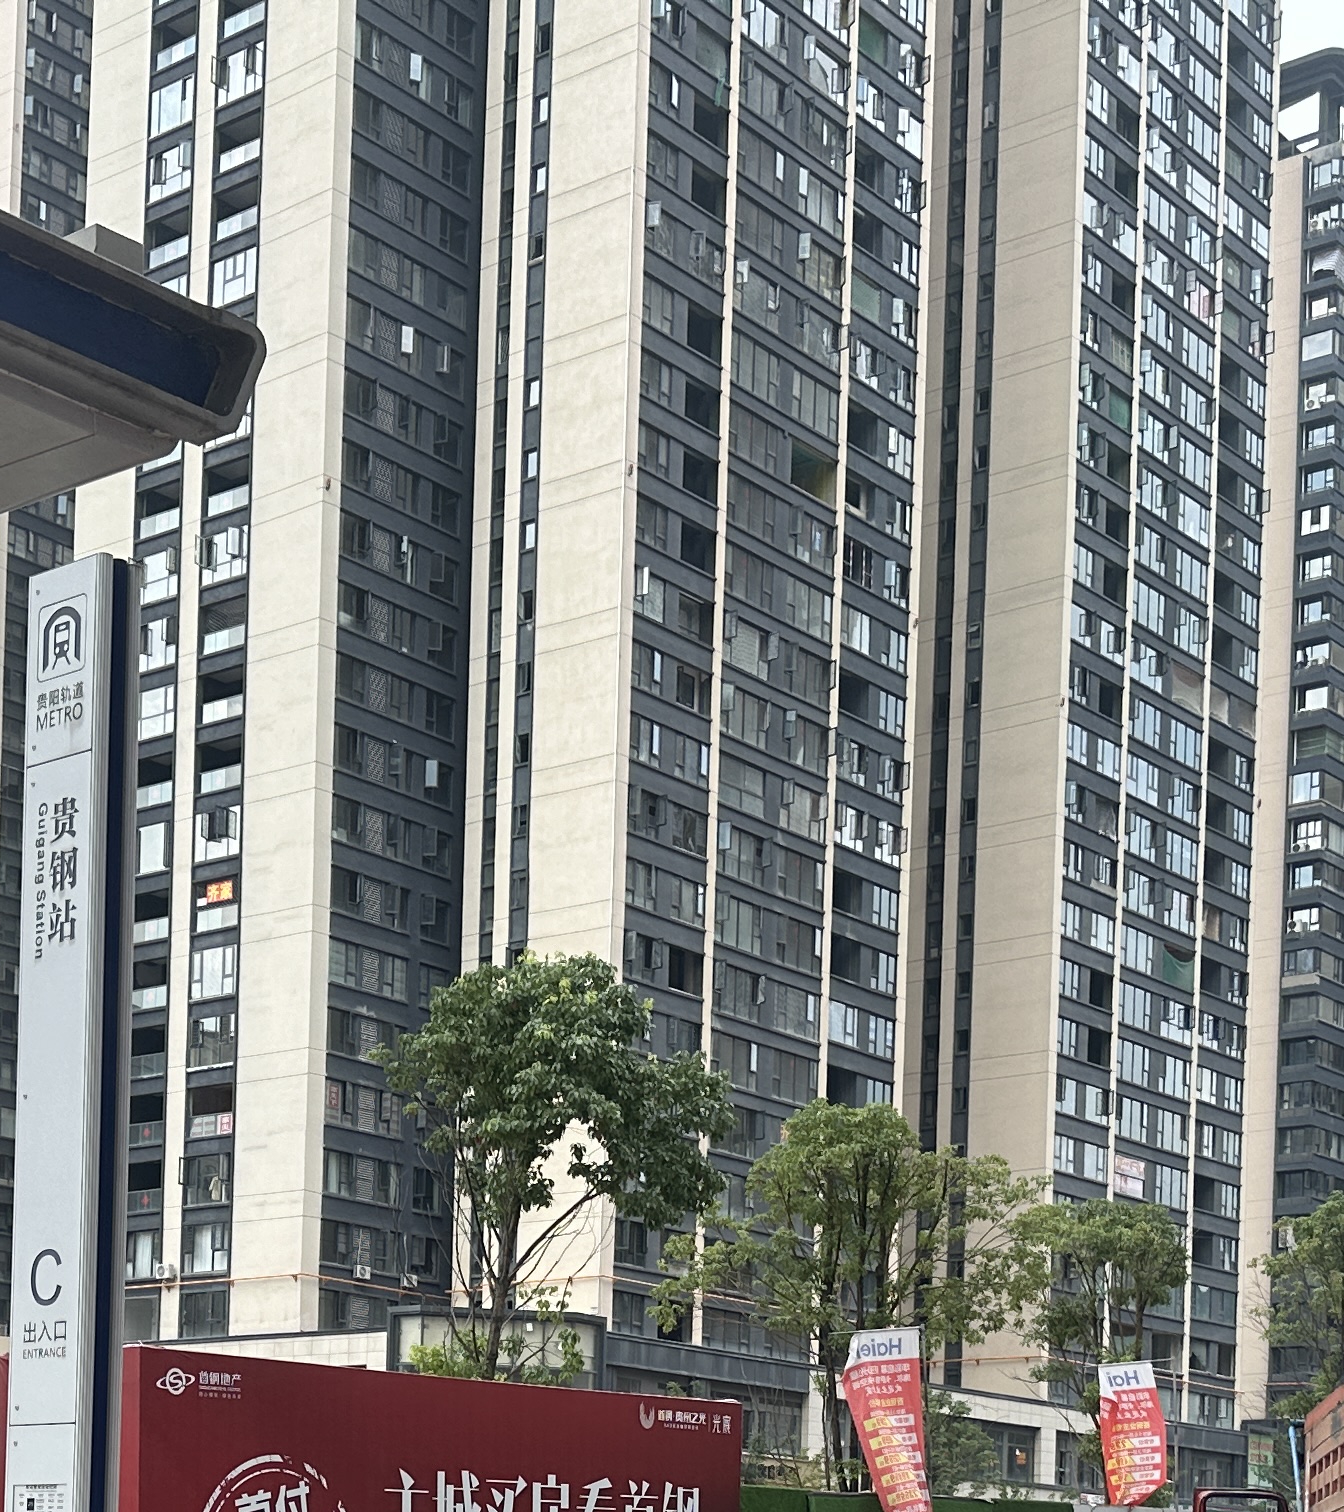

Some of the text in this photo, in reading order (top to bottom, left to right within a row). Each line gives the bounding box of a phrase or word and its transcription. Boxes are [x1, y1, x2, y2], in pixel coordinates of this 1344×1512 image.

[36, 680, 84, 712] 贵阳轨道
[36, 702, 83, 732] METRO
[34, 802, 48, 960] Guigang Station
[48, 795, 80, 945] 贵钢站
[30, 1248, 62, 1306] C
[23, 1320, 67, 1344] 出入口
[22, 1346, 67, 1360] ENTRANCE
